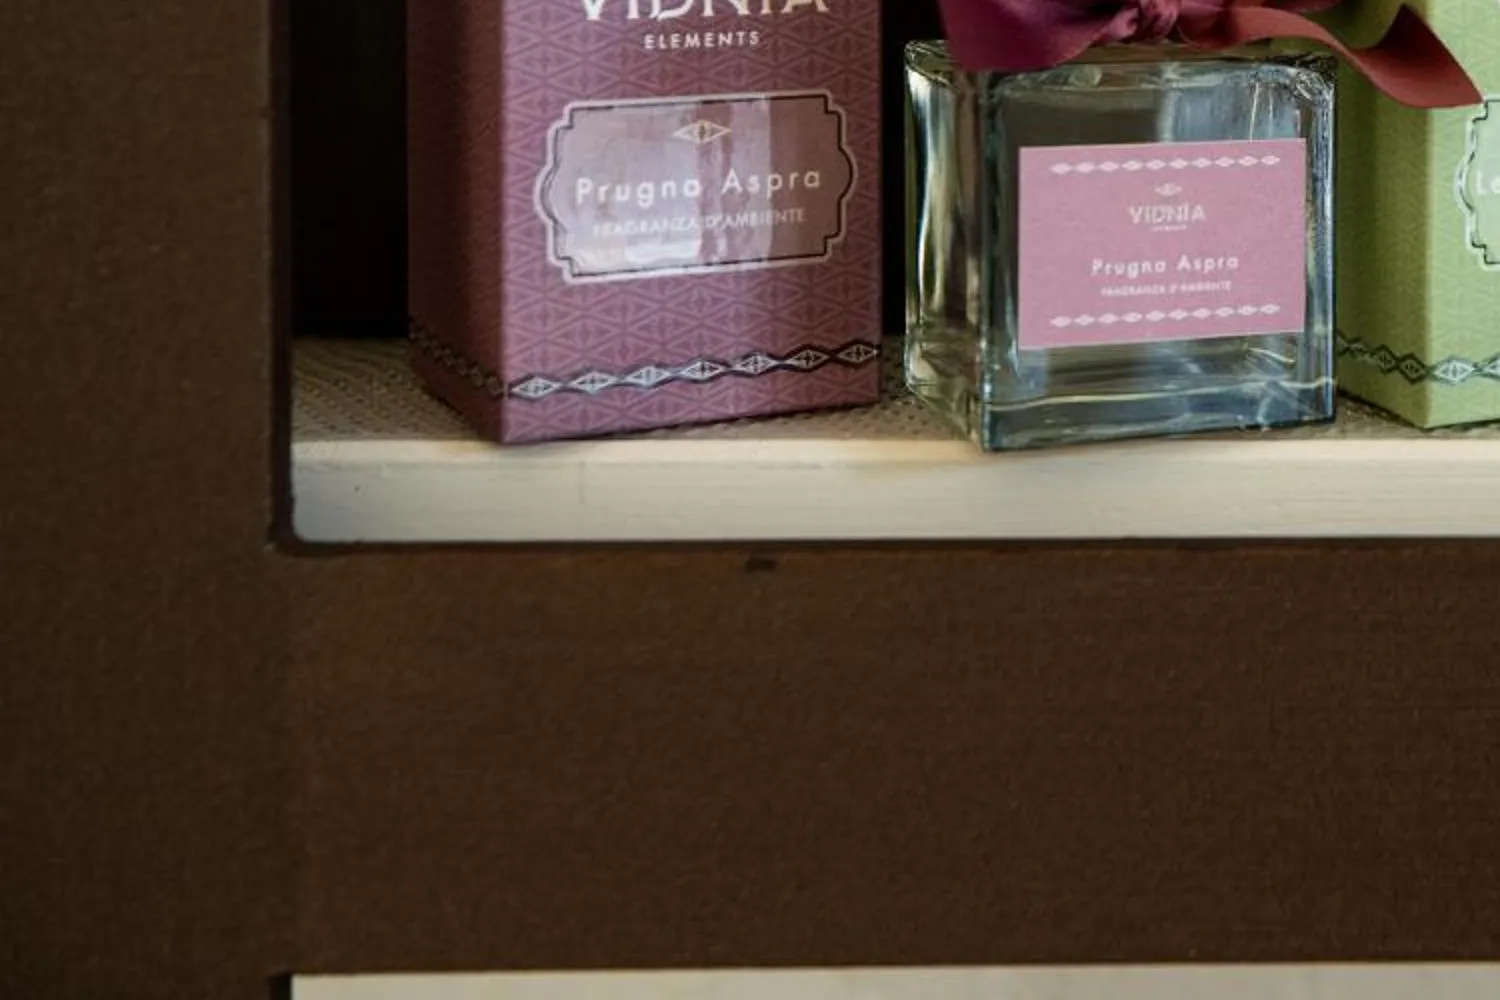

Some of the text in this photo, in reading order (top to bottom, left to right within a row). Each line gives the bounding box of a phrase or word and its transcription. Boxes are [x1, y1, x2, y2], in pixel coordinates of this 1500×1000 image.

[643, 30, 761, 50] ELEMENTS
[575, 167, 821, 209] Prugna Aspra
[1091, 254, 1239, 278] Prugna Aspra
